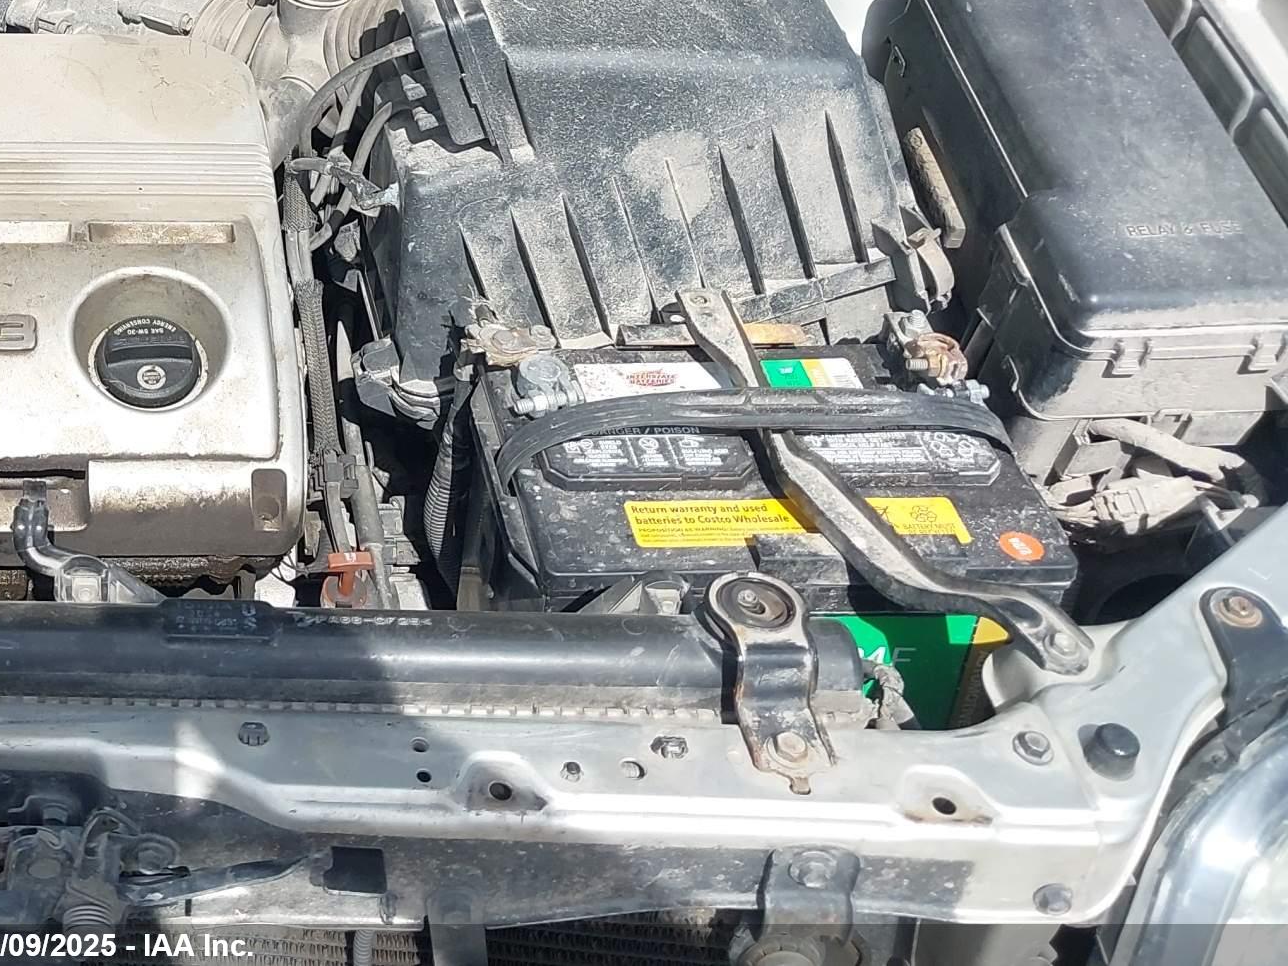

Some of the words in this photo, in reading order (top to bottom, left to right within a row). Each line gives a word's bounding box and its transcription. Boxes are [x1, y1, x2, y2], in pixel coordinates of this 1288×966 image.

[1126, 223, 1175, 236] RELAY
[654, 426, 701, 434] POISON
[631, 506, 667, 514] Return
[670, 506, 717, 514] warranty
[720, 504, 740, 512] and
[742, 504, 768, 512] used
[635, 516, 682, 524] batteries
[698, 515, 729, 523] Costco
[730, 514, 790, 523] Wholesale
